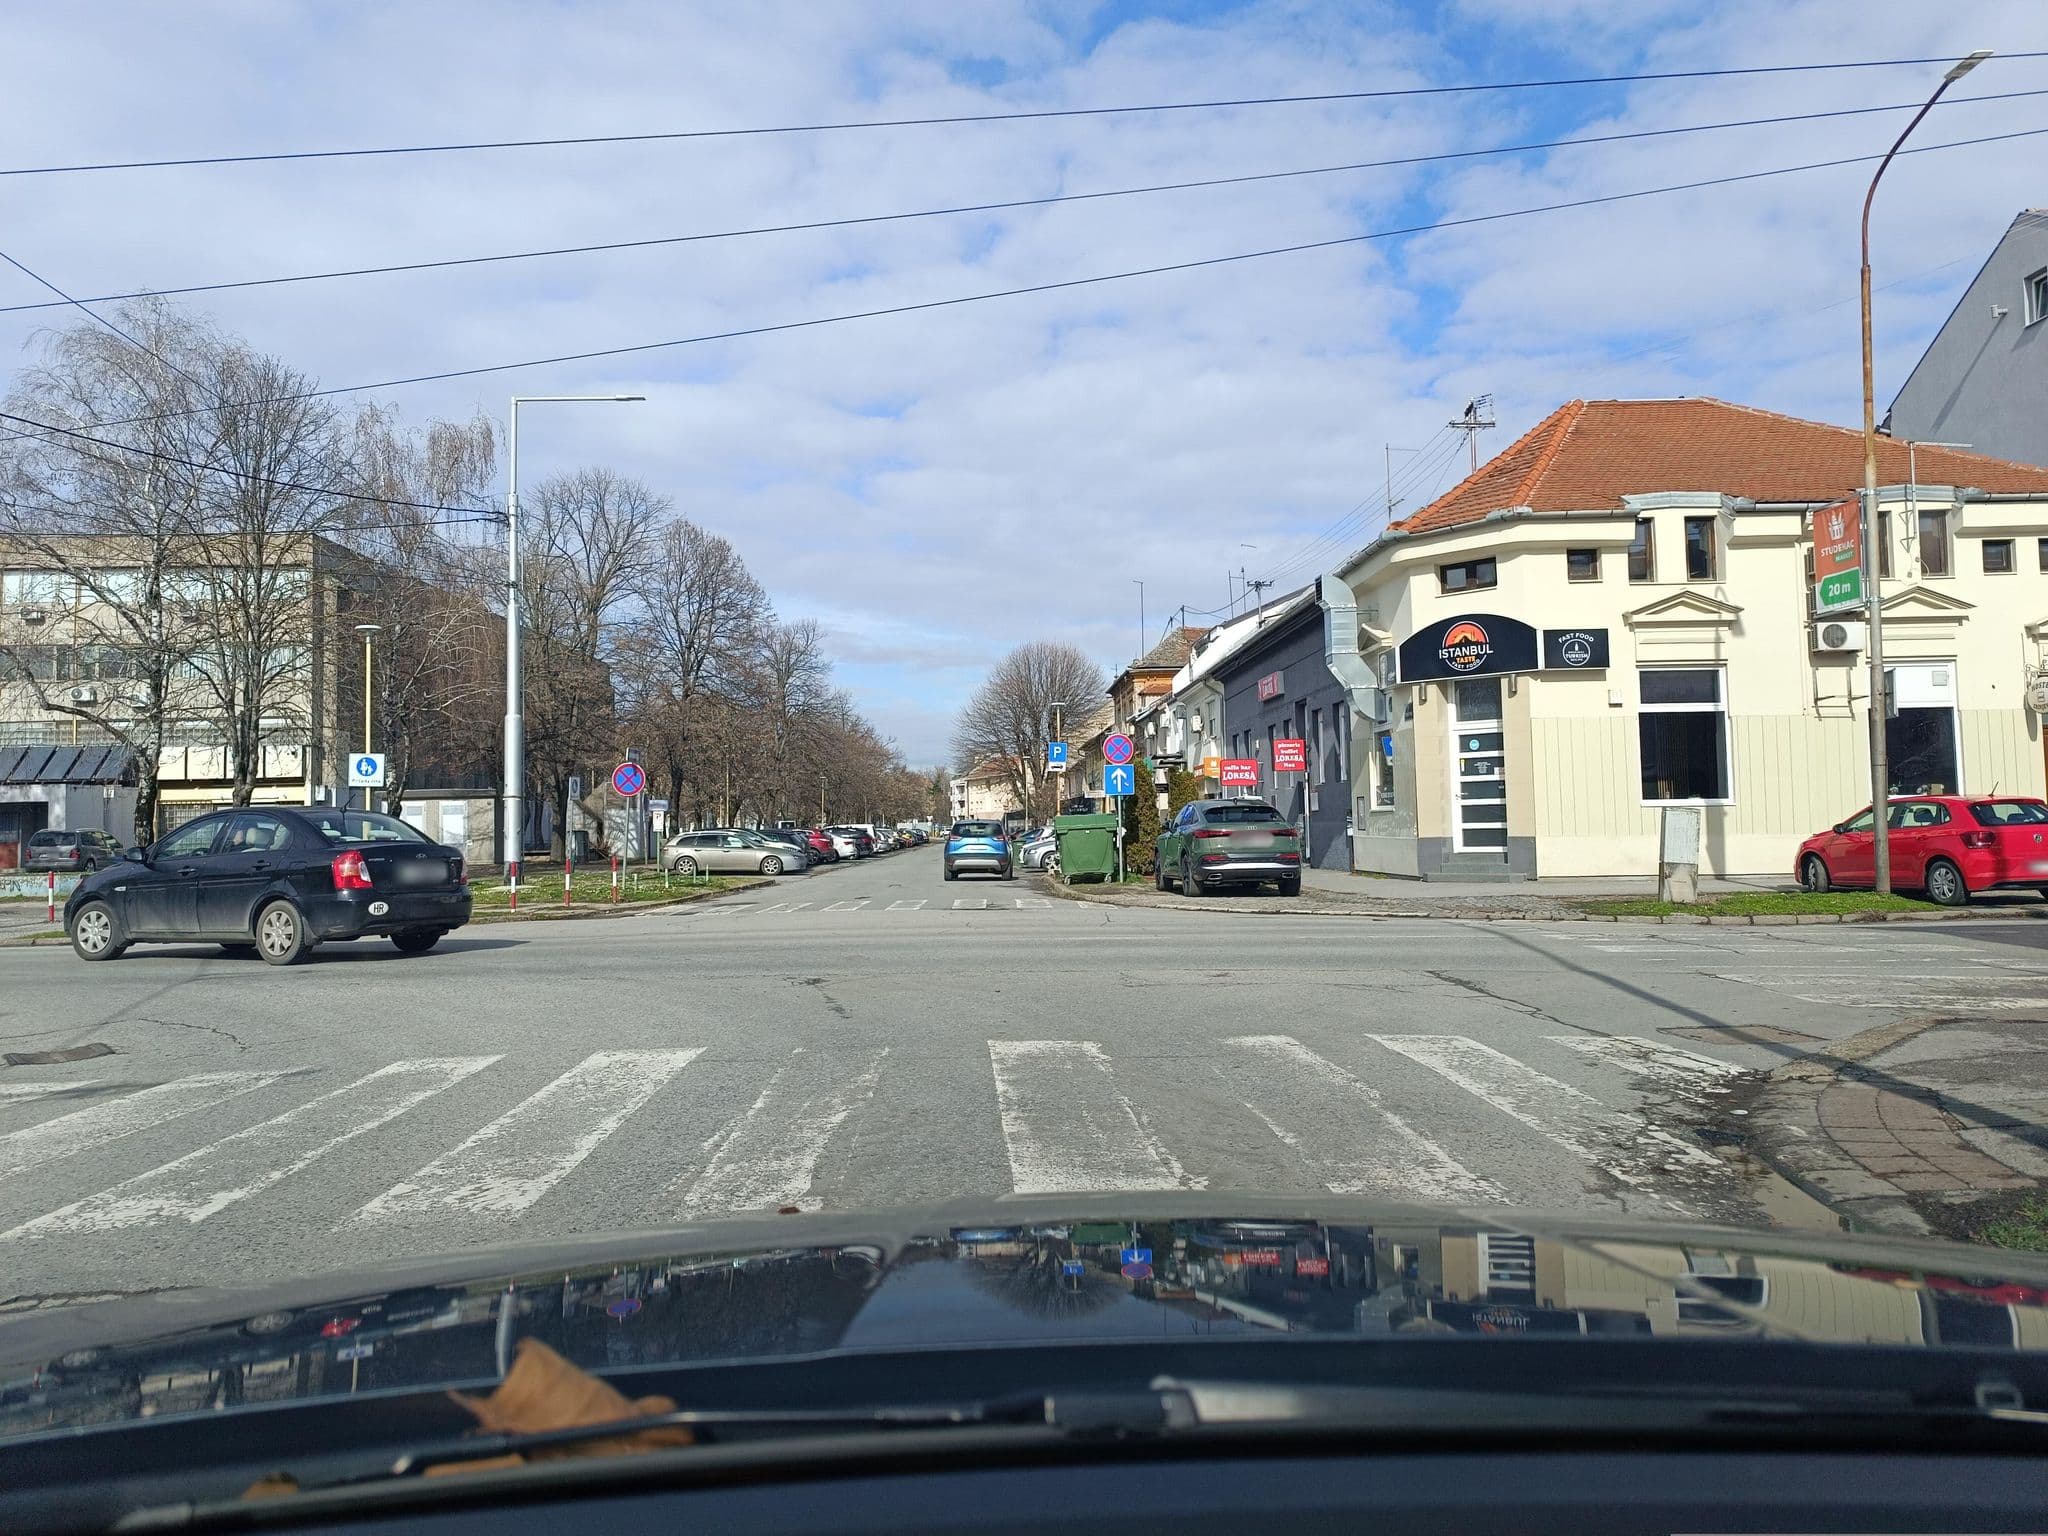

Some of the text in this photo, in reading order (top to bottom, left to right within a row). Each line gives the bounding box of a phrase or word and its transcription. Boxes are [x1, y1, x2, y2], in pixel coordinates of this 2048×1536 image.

[1820, 539, 1855, 557] STUDENAC
[1828, 583, 1851, 597] 20 m
[1558, 632, 1594, 643] FAST FOOD
[1439, 644, 1494, 659] ISTANBUL
[1456, 655, 1476, 664] TASTE
[1053, 746, 1061, 758] P
[1222, 770, 1256, 780] LORESA
[373, 904, 385, 913] HR
